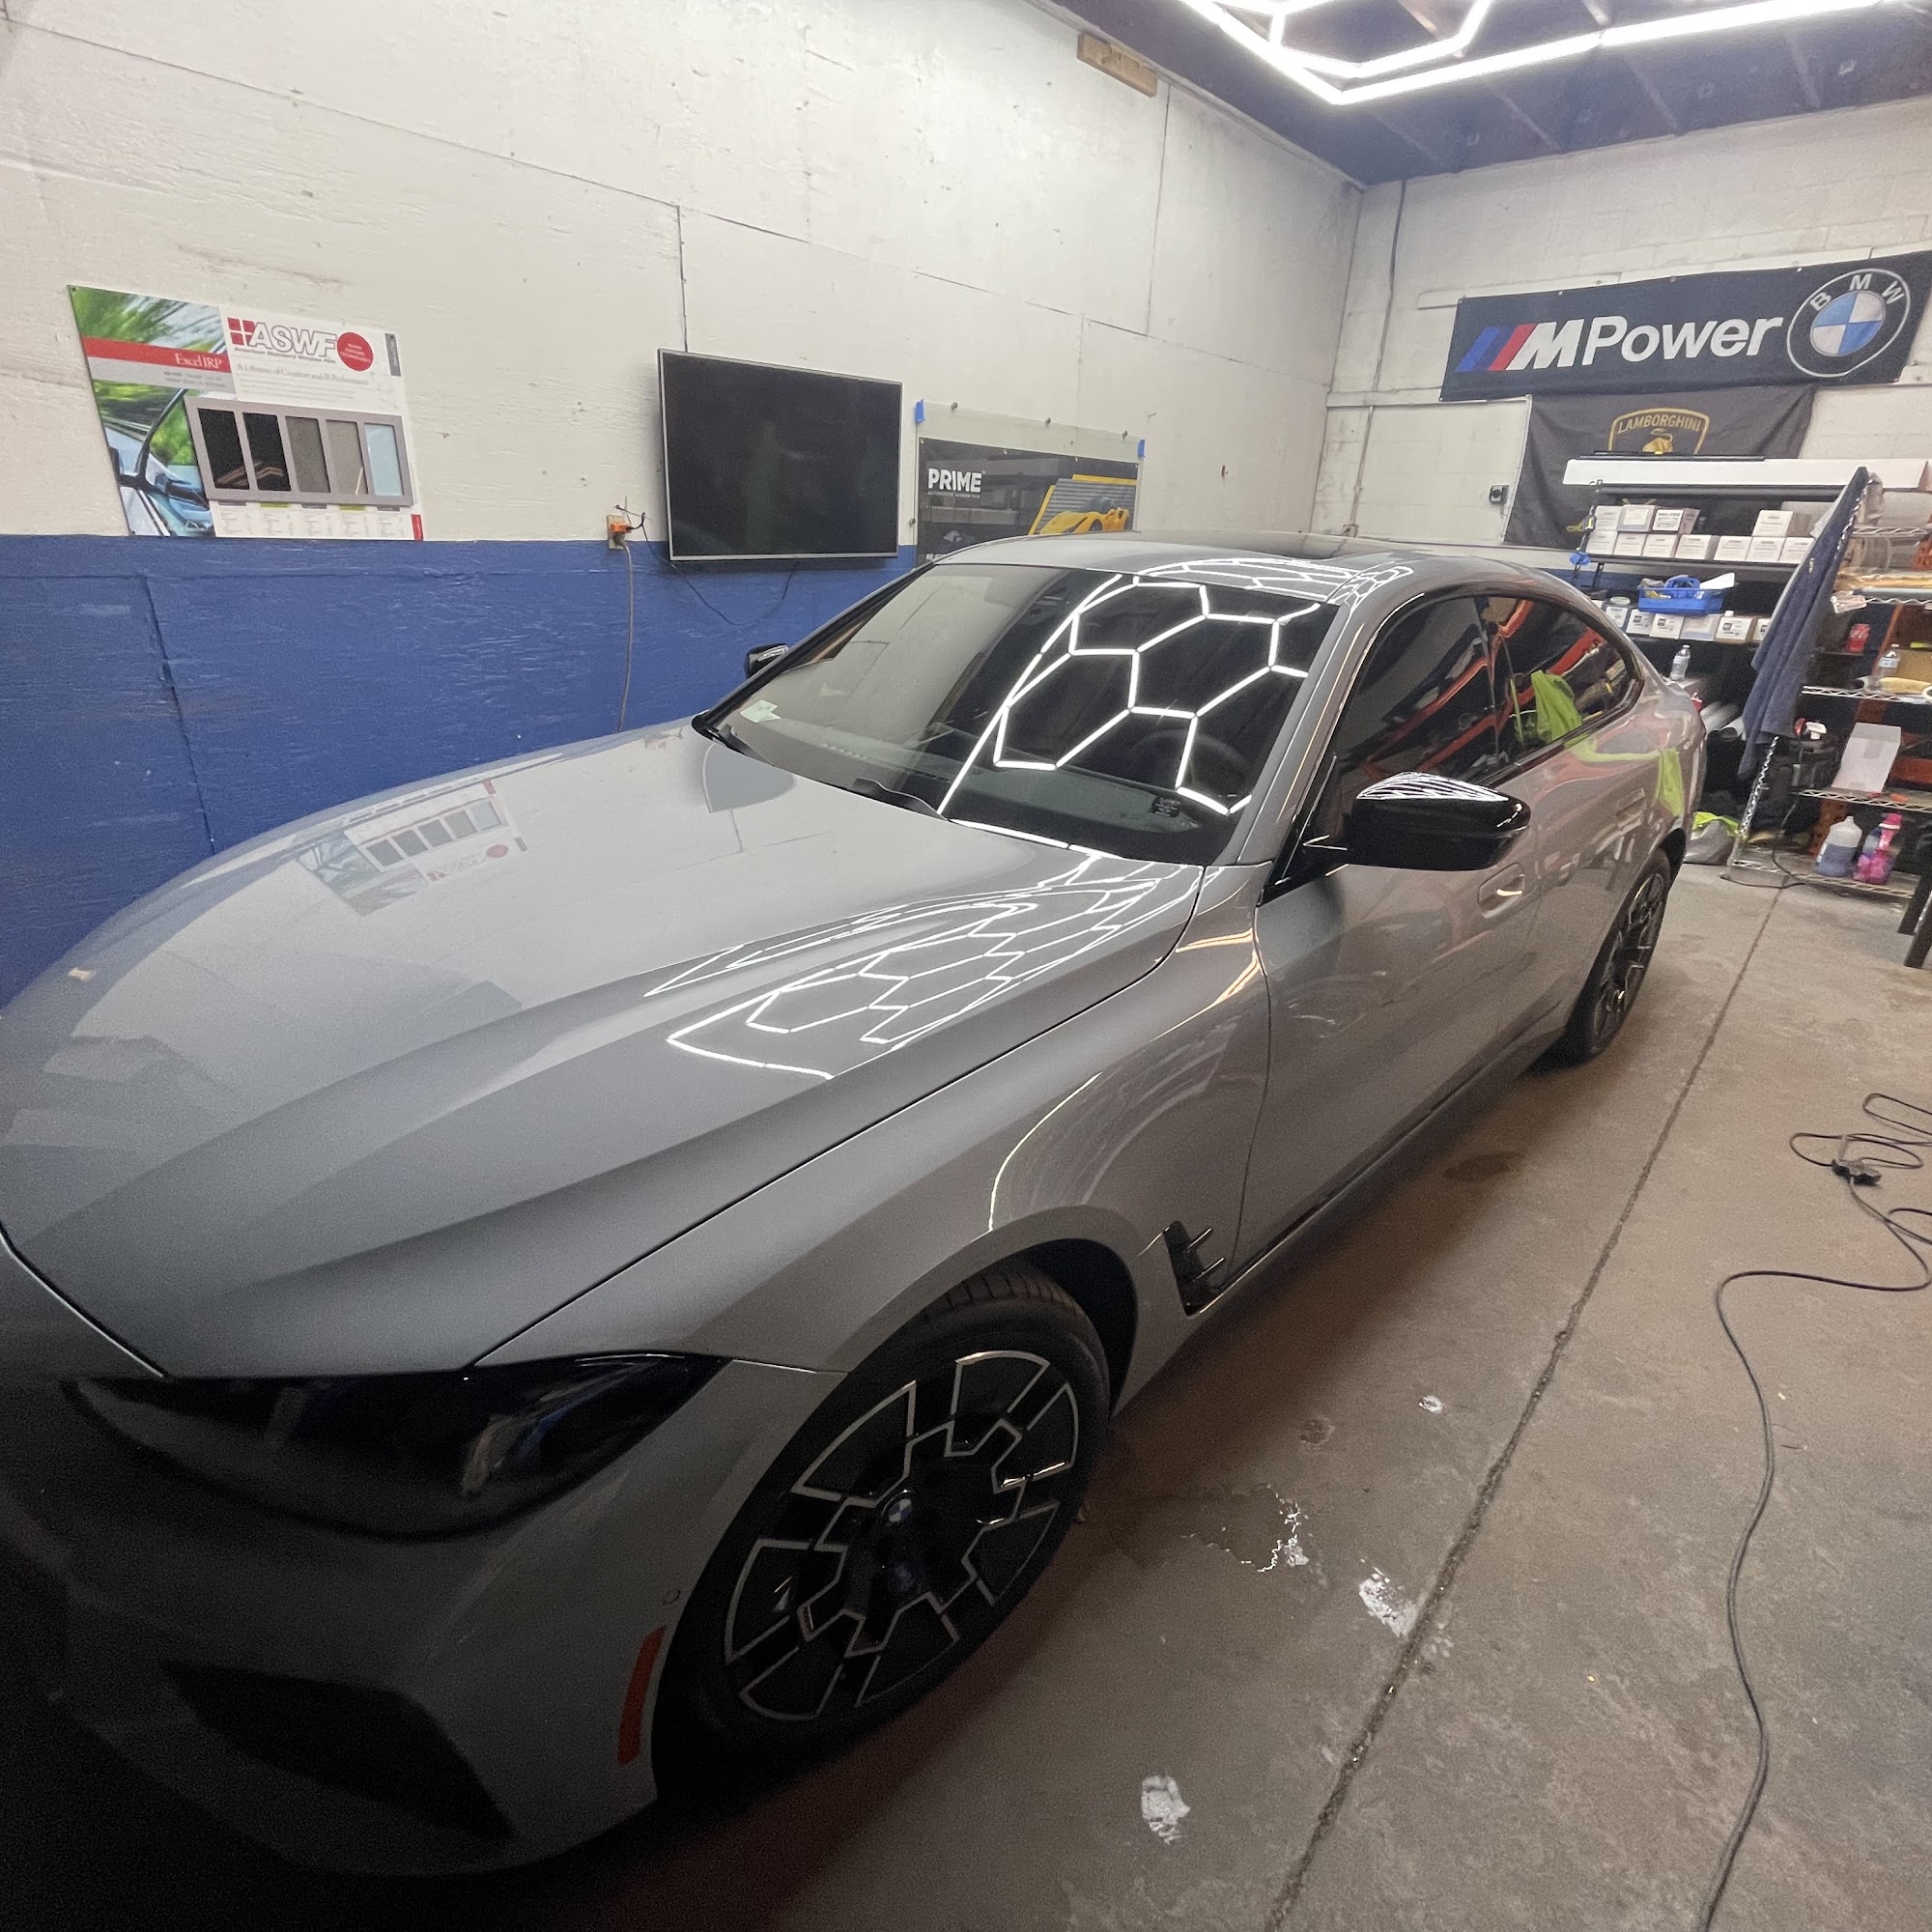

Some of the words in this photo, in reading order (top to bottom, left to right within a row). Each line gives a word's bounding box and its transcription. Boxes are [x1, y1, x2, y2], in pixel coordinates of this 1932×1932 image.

[1809, 273, 1905, 312] BMW
[249, 322, 337, 357] ASWF
[1617, 414, 1702, 434] LAMBORGHINI
[927, 468, 982, 493] PRIME
